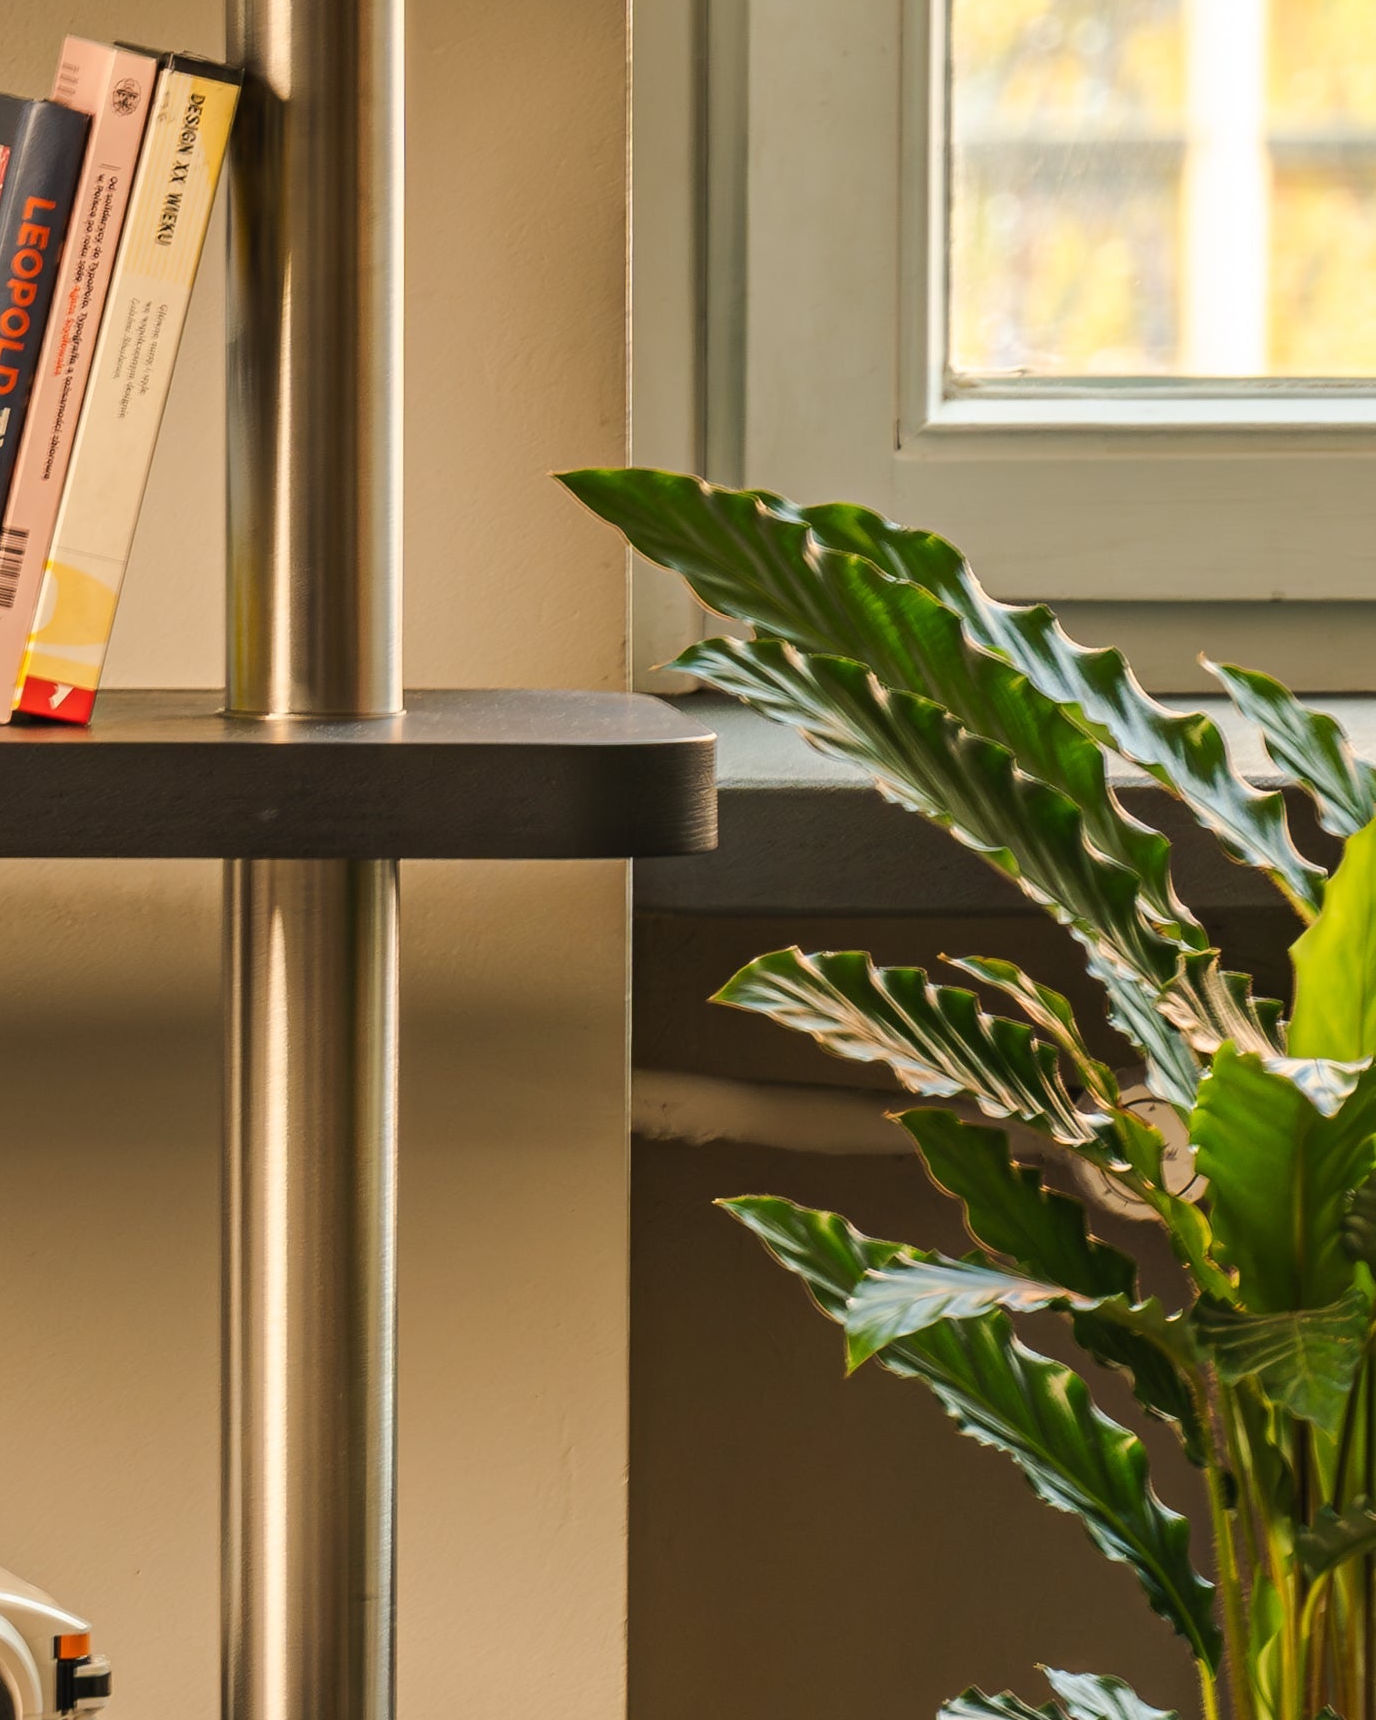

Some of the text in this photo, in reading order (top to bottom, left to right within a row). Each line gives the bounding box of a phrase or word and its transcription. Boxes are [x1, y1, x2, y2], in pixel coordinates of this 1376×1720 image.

[156, 93, 206, 245] DESIGN XX WIEKU
